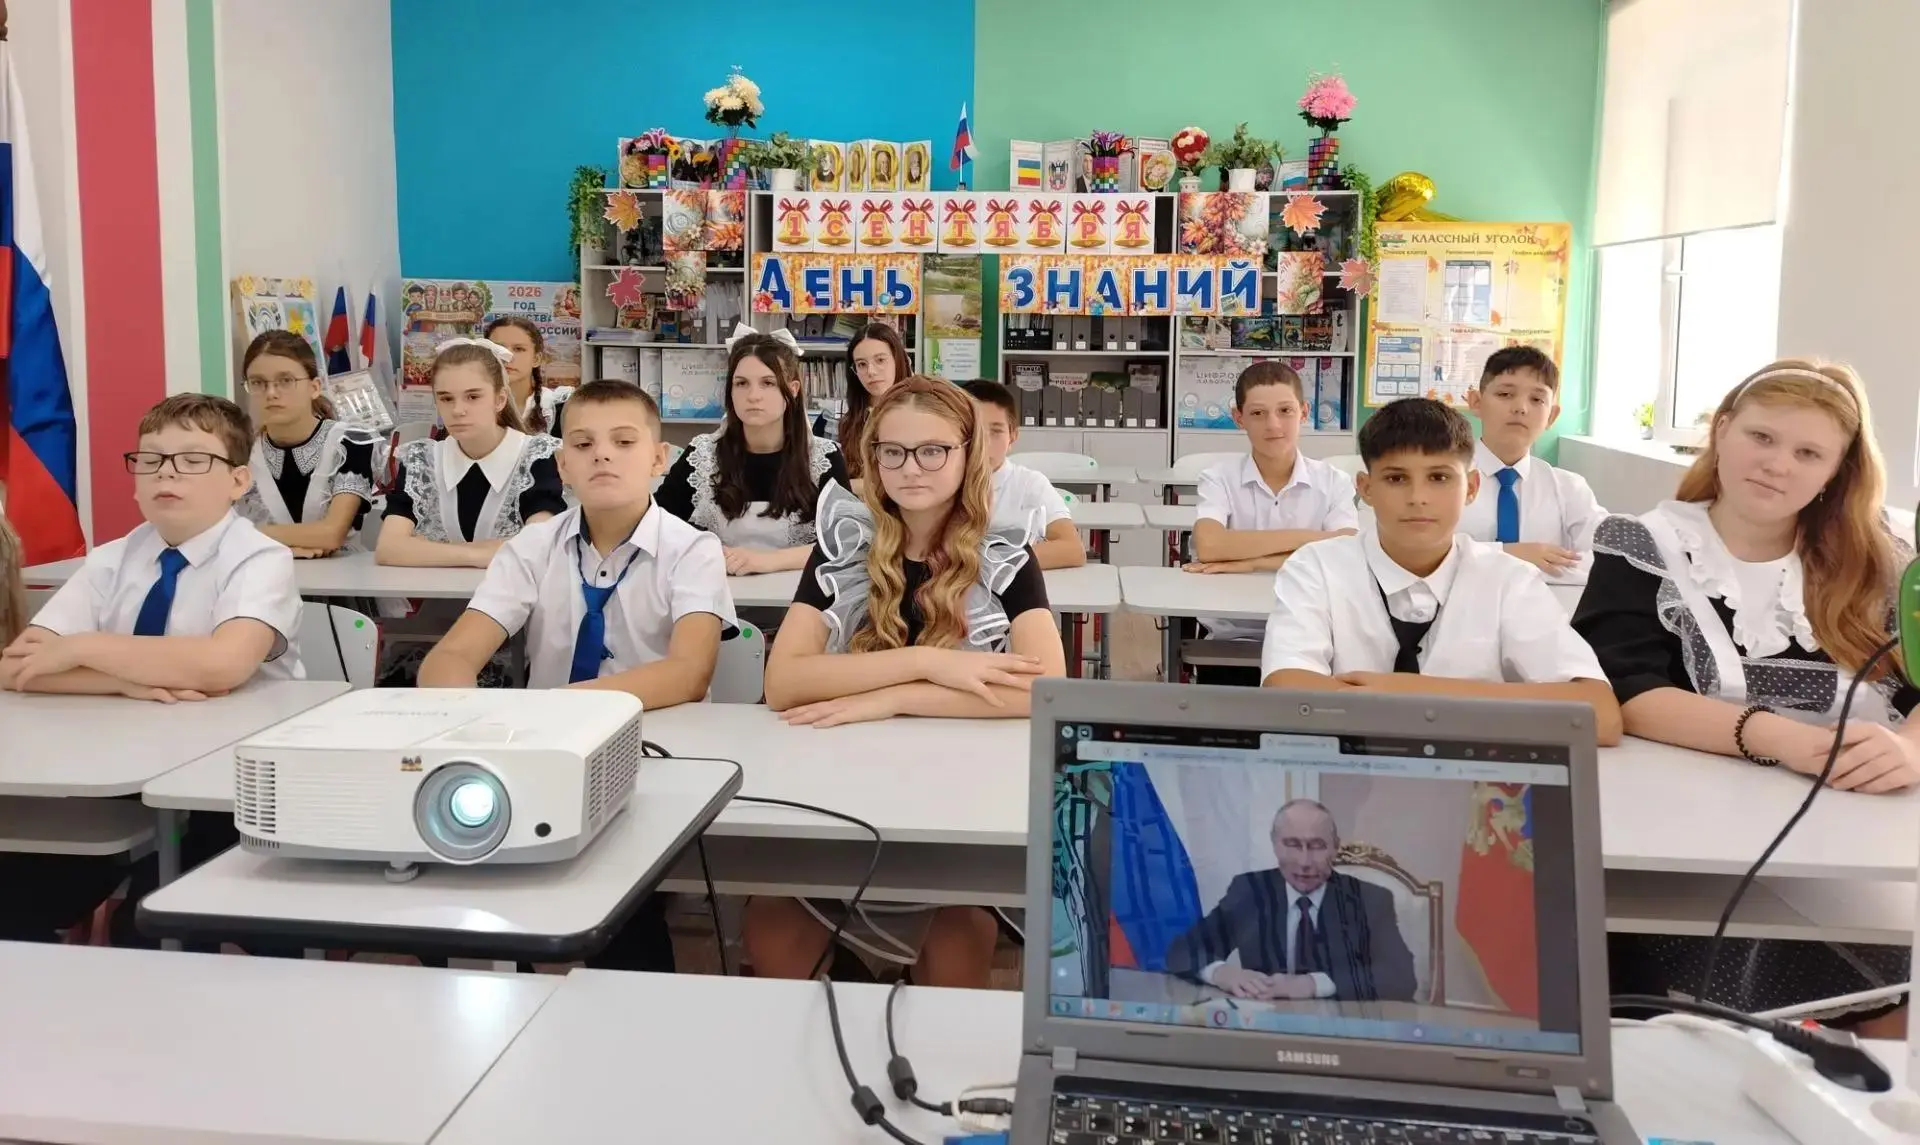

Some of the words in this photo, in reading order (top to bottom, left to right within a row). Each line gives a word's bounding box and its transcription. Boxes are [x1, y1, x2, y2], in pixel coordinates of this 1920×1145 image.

[788, 216, 801, 237] 1
[826, 218, 1141, 239] СЕНТЯБРЯ
[1411, 232, 1480, 244] КЛАССНЫЙ
[1486, 234, 1536, 244] УГОЛОК
[756, 257, 913, 309] ДЕНЬ
[1006, 260, 1257, 309] ЗНАНИЙ
[508, 286, 542, 297] 2026
[514, 301, 536, 311] ГОД
[539, 326, 578, 336] ОССИИ
[1276, 1049, 1340, 1067] SAMSUNG
